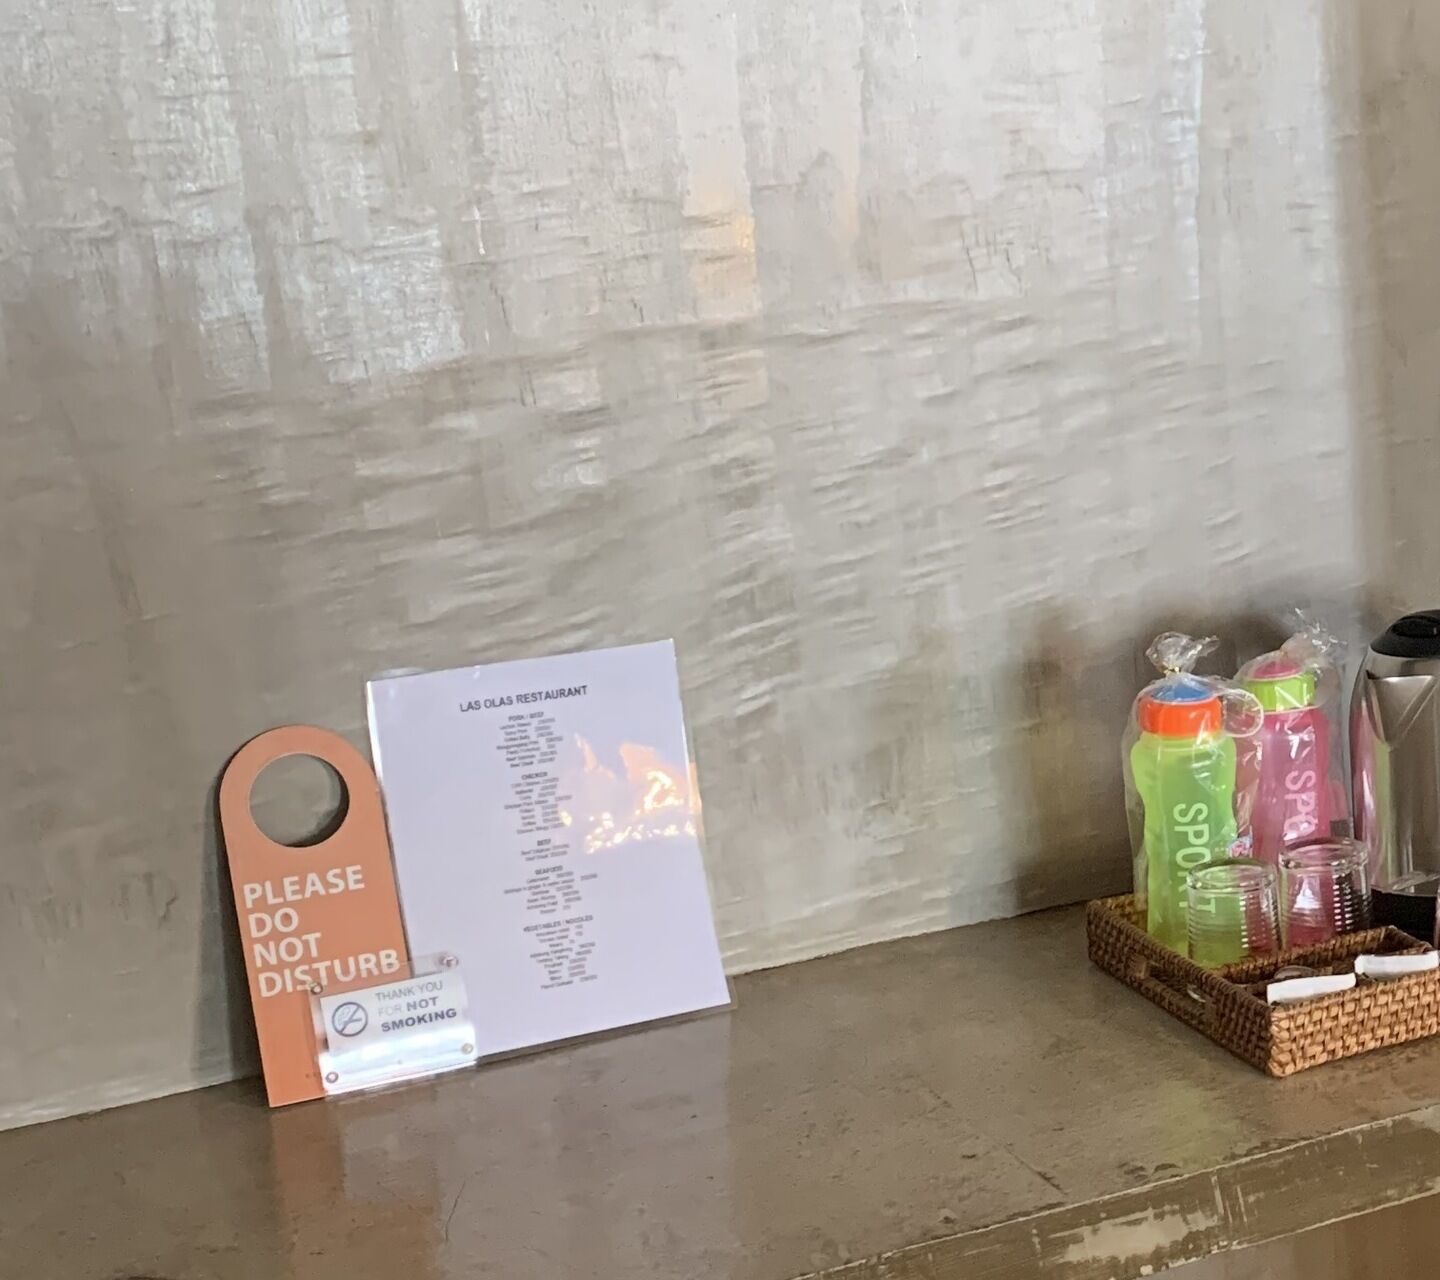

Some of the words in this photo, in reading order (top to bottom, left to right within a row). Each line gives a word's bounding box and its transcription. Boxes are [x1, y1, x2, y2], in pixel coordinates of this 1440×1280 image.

[459, 699, 481, 712] LAS
[484, 695, 513, 709] OLAS
[515, 685, 588, 704] RESTAURANT
[1283, 770, 1318, 841] SPO
[243, 864, 365, 908] PLEASE
[248, 907, 299, 938] DO
[252, 932, 321, 968] NOT
[257, 949, 400, 998] DISTURB
[375, 985, 414, 1002] THANK
[417, 980, 443, 995] YOU
[377, 1002, 405, 1017] FOR
[406, 996, 439, 1012] NOT
[381, 1008, 457, 1032] SMOKING
